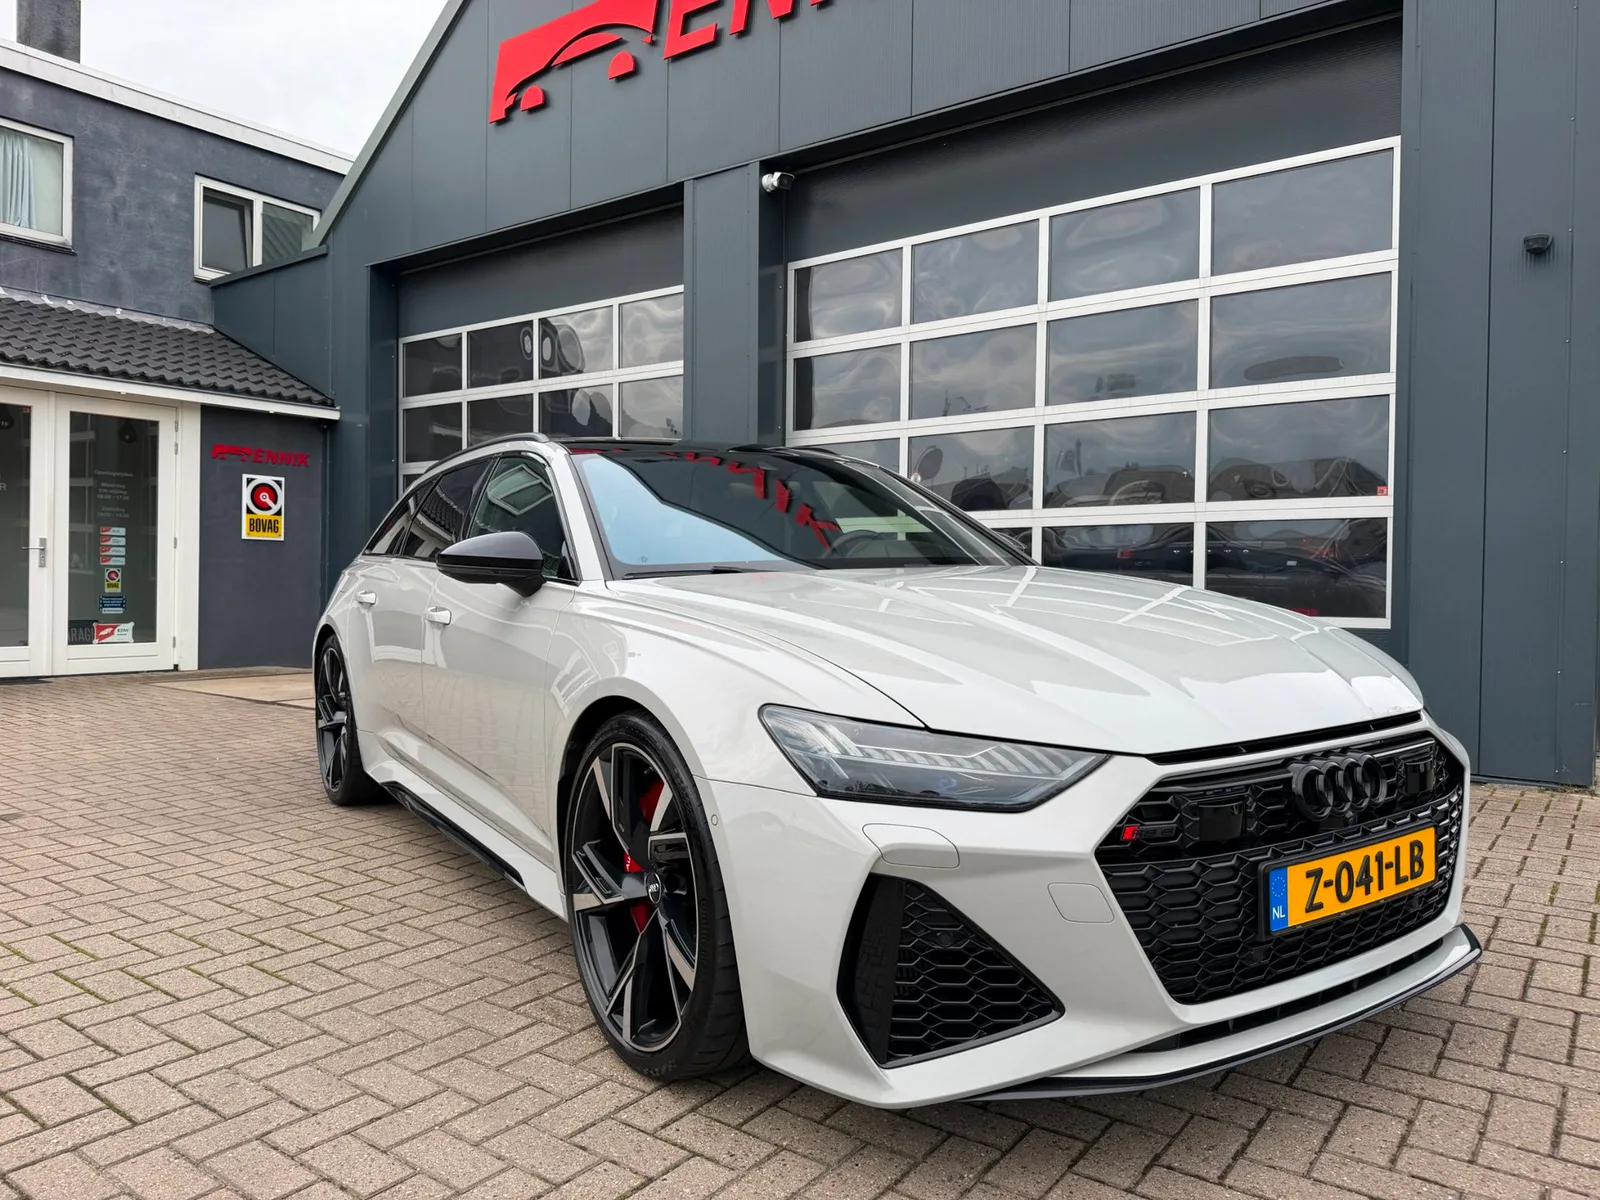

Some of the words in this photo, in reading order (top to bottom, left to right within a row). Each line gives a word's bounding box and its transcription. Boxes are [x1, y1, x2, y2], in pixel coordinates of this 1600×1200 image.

[249, 518, 279, 533] BOVAG
[1305, 839, 1424, 914] Z-041-LB
[1272, 905, 1286, 920] NL
